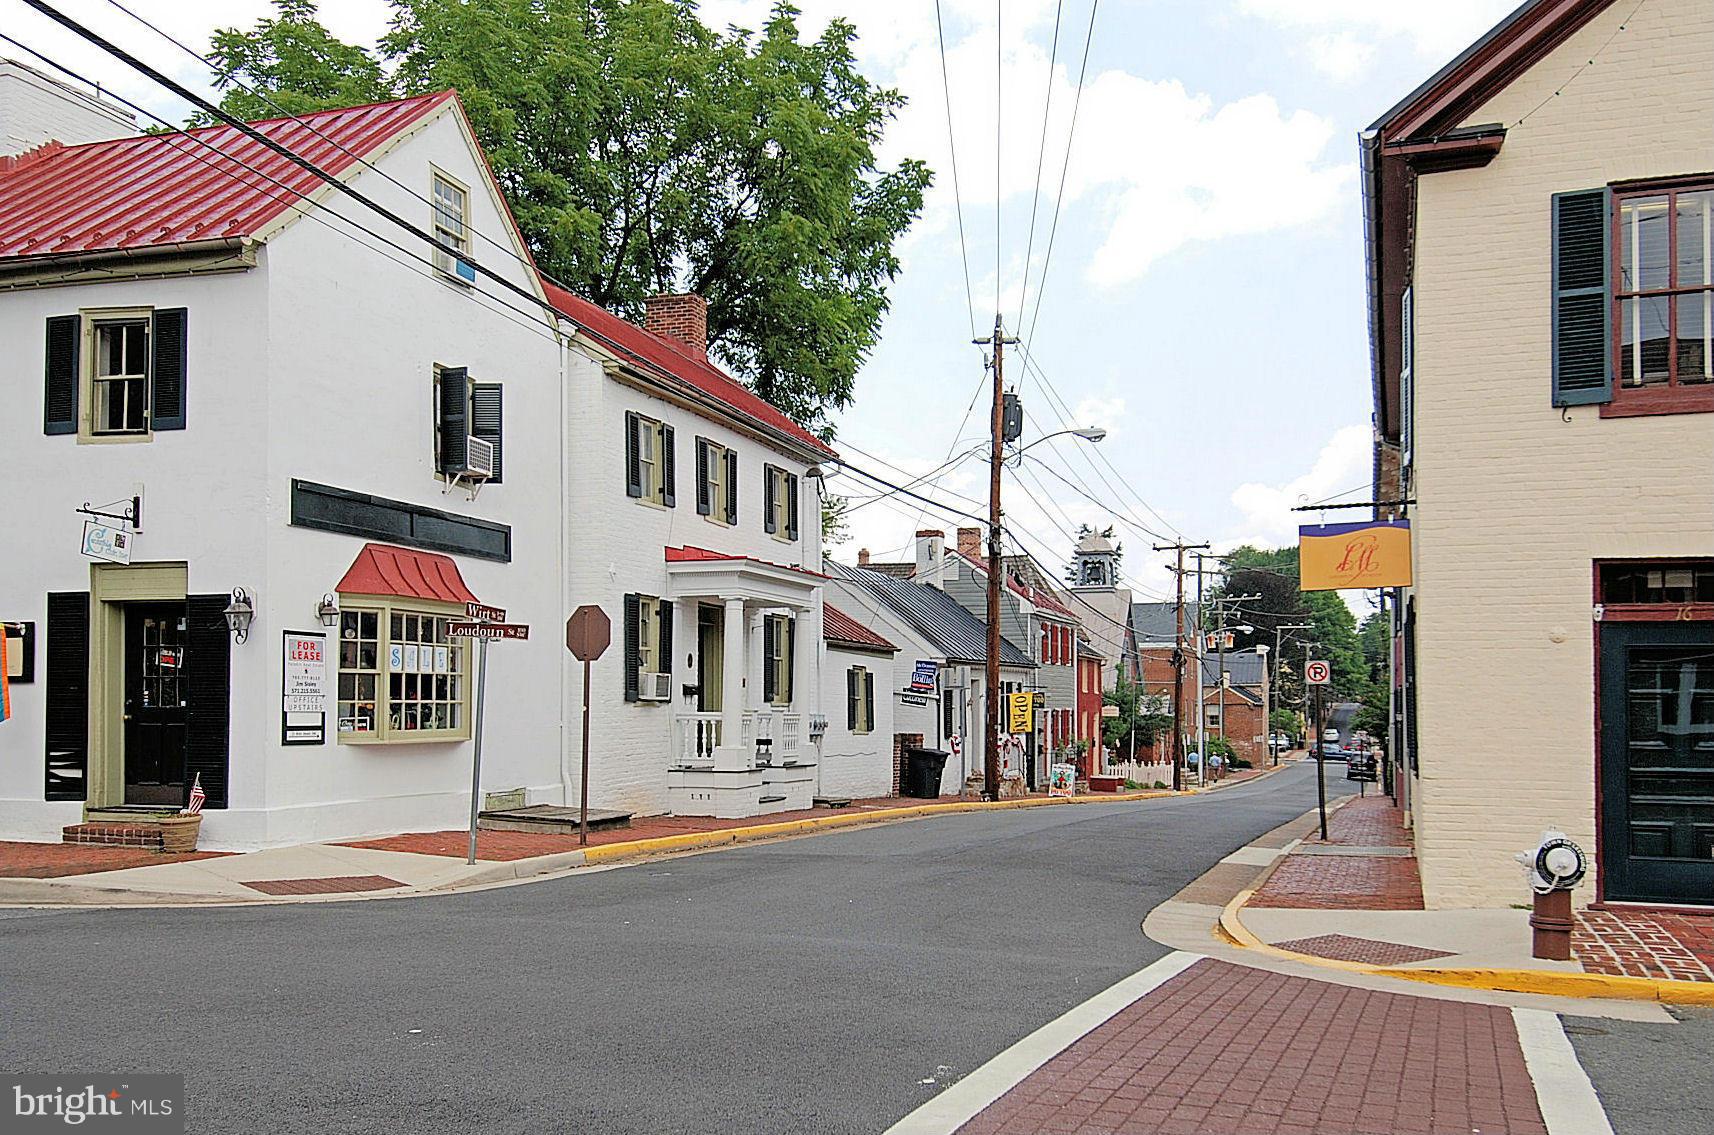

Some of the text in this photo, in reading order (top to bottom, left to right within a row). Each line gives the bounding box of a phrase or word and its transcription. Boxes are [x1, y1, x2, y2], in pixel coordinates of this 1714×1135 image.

[467, 603, 491, 619] Wirt
[1676, 606, 1693, 621] 16
[448, 623, 504, 638] Loudoun
[297, 641, 315, 650] FOR
[292, 651, 321, 661] LEASE
